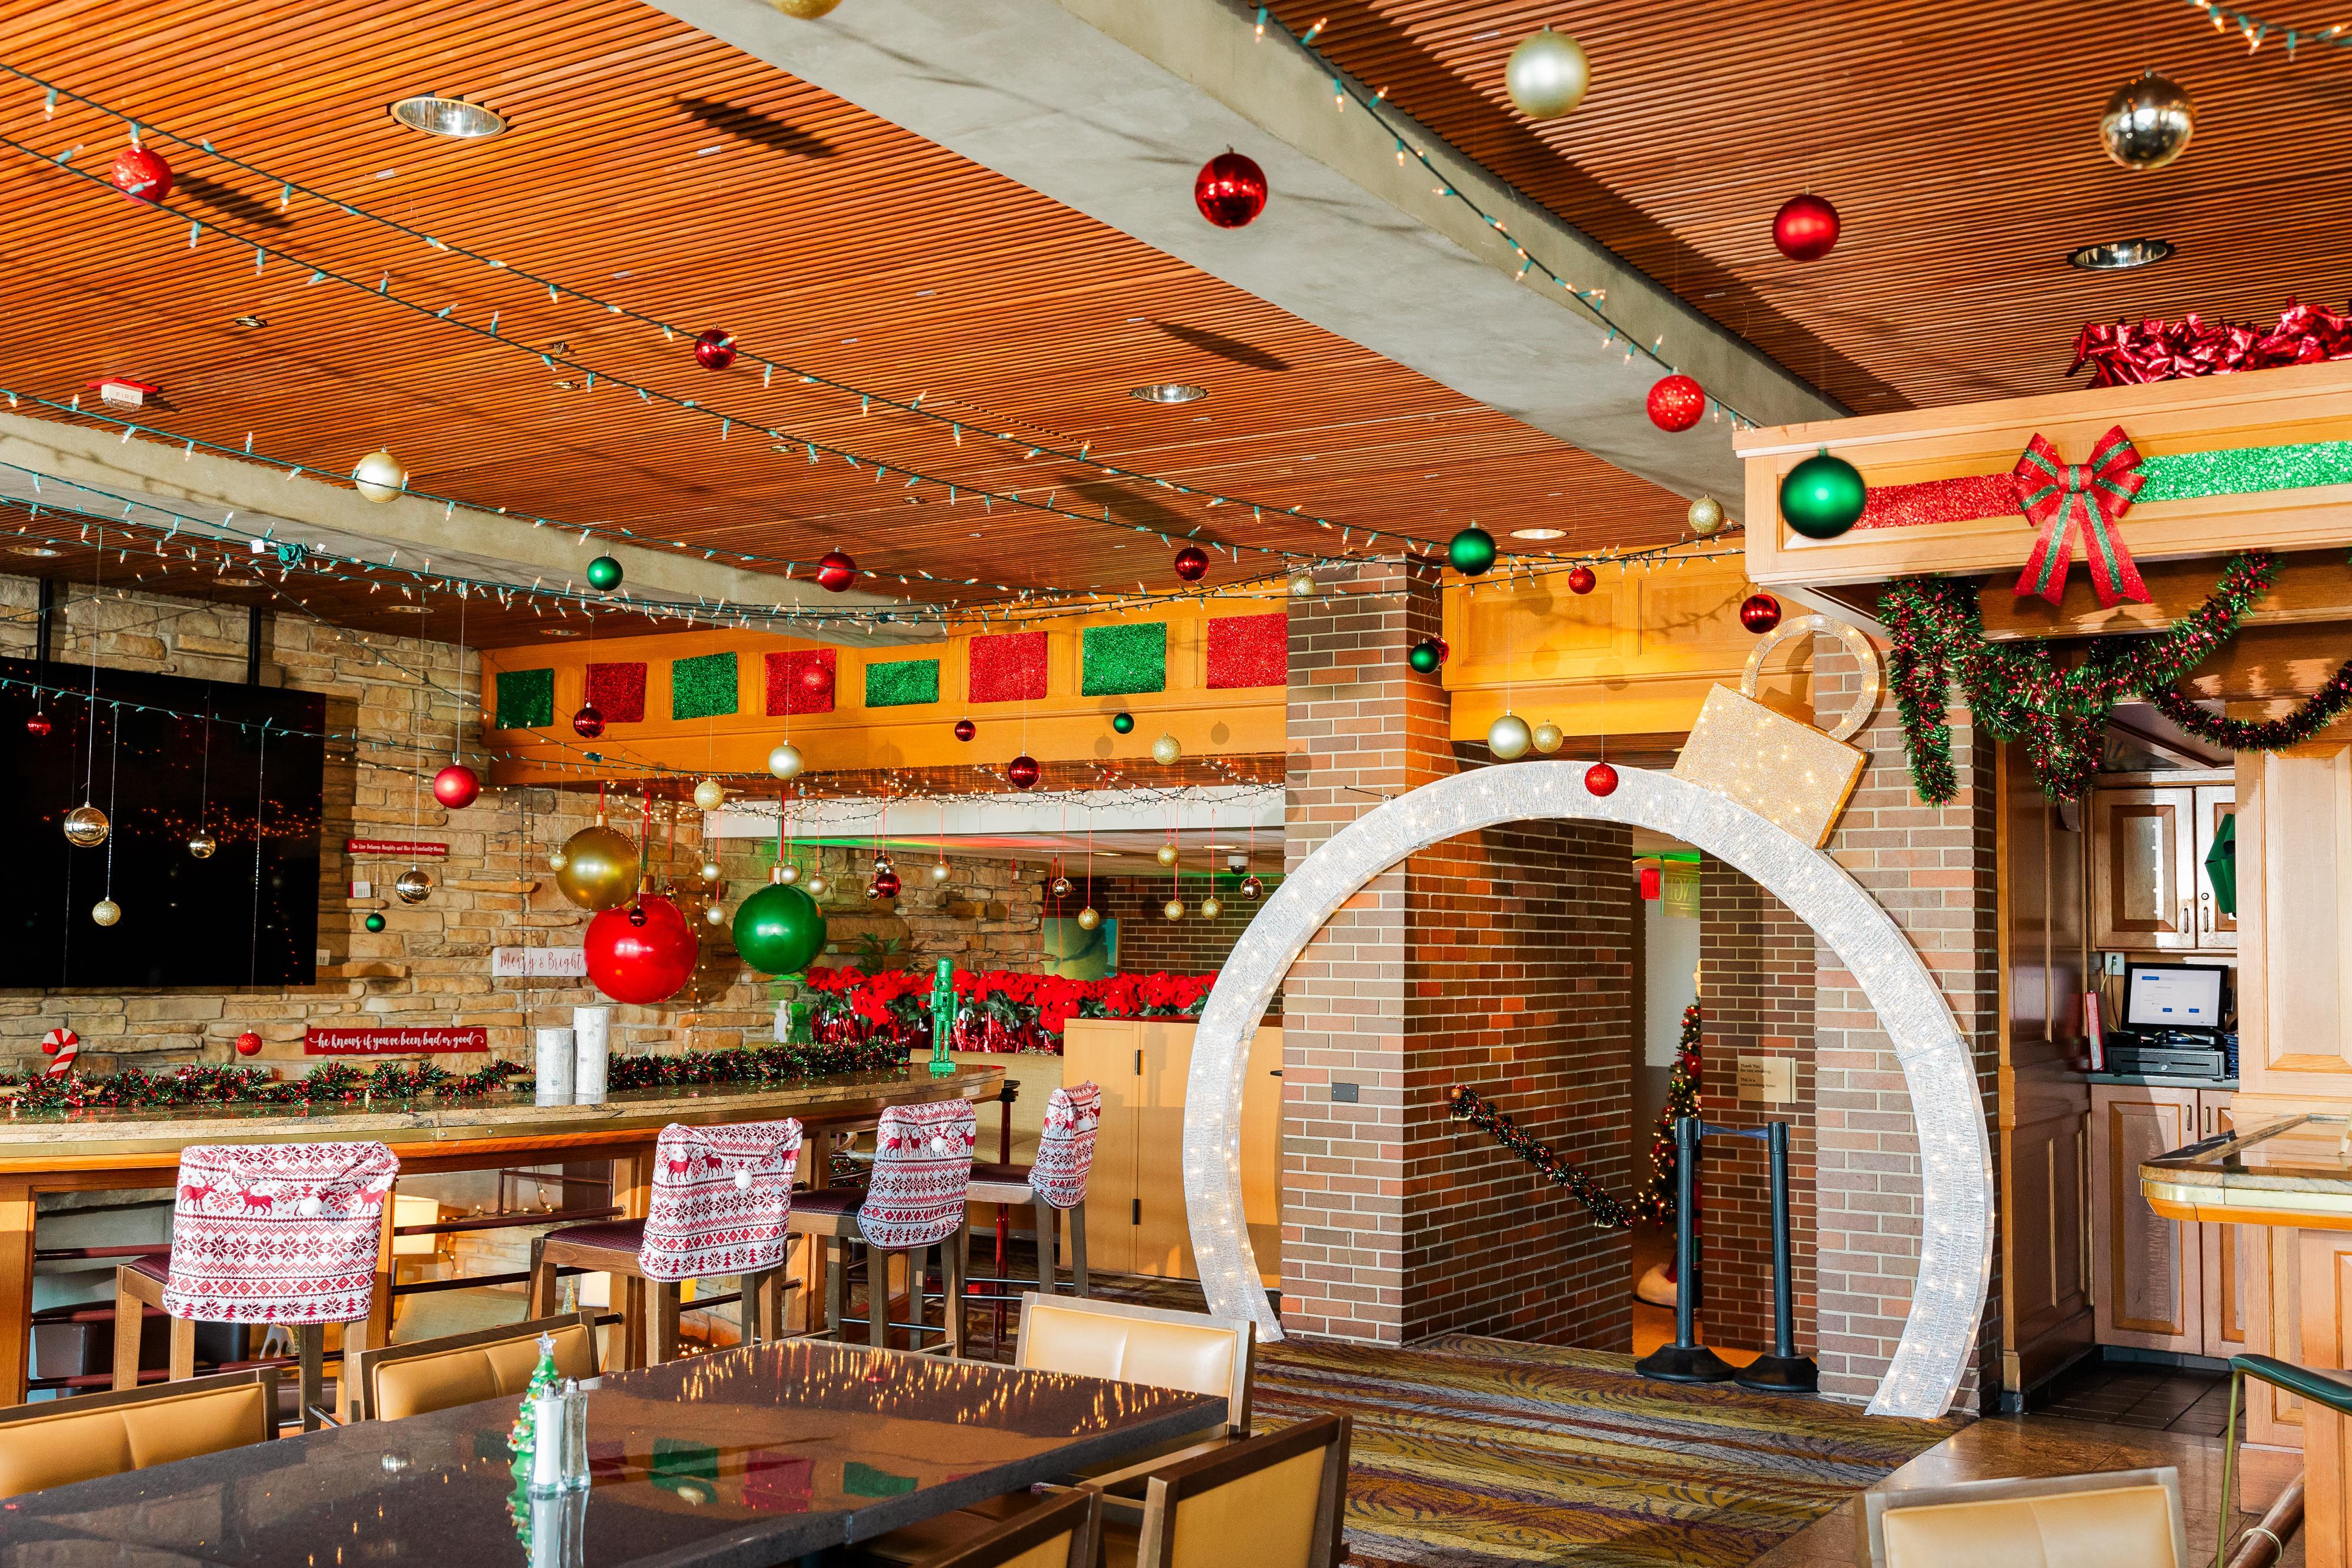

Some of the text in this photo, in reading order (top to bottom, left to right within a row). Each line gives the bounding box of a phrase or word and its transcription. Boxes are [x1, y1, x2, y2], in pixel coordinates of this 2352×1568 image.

[116, 392, 135, 401] FIRE
[500, 952, 536, 974] Merry
[547, 951, 583, 974] Bright
[309, 1032, 330, 1048] he
[332, 1034, 362, 1049] knows
[363, 1034, 372, 1049] if
[400, 1031, 422, 1047] been
[423, 1031, 442, 1047] bad
[442, 1037, 453, 1047] or
[453, 1031, 484, 1048] good
